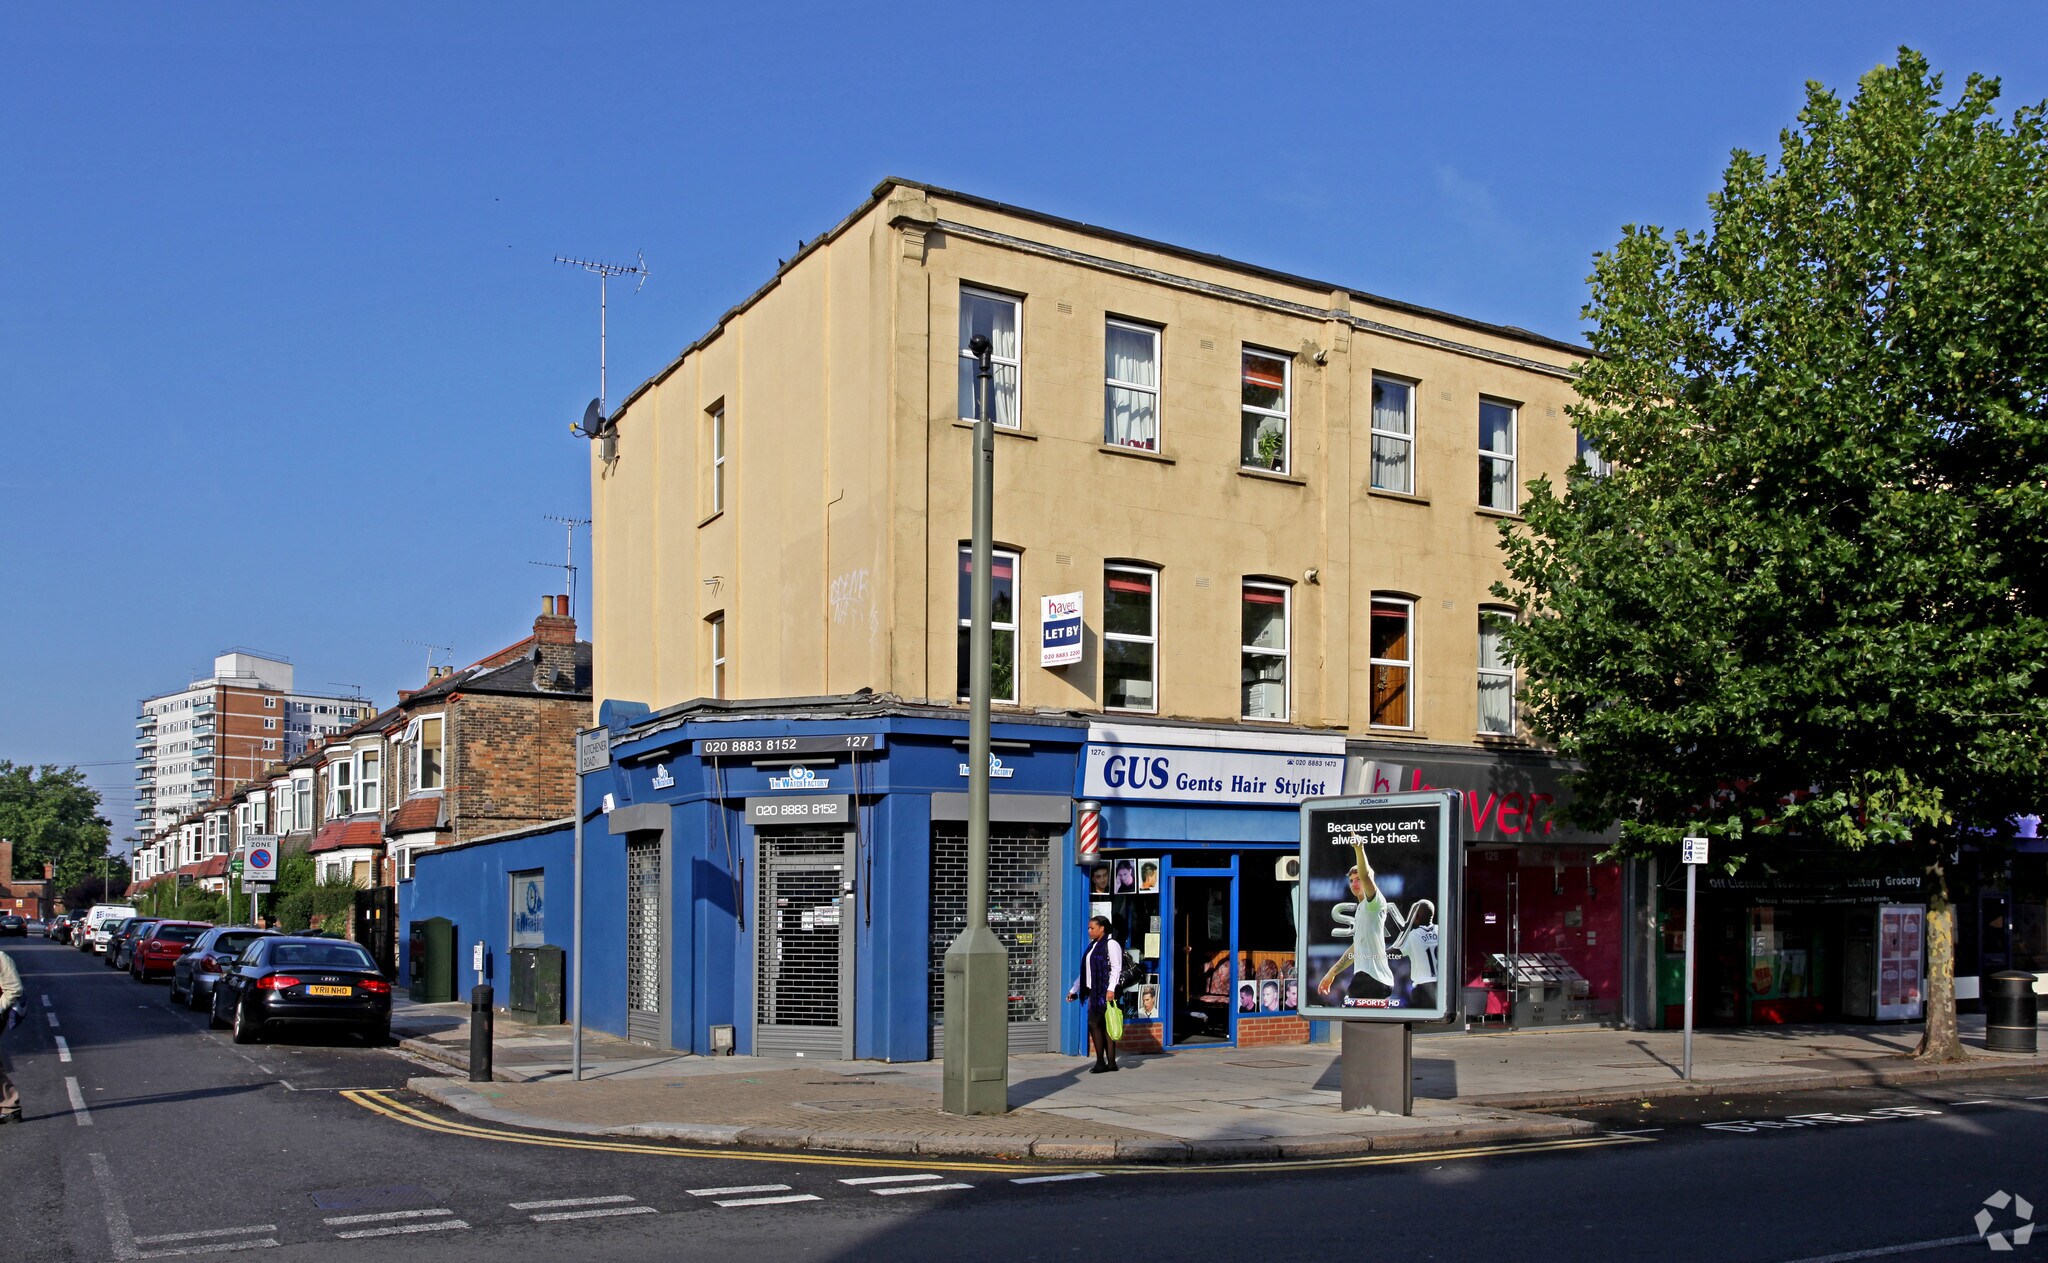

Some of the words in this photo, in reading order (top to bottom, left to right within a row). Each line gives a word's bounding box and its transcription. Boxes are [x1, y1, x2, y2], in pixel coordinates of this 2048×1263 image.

[1048, 599, 1075, 614] haven
[1045, 627, 1065, 640] LET
[1066, 625, 1079, 637] BY
[583, 740, 608, 756] KITCHENER
[705, 742, 728, 752] 020
[731, 740, 762, 751] 8883
[766, 739, 797, 750] 8152
[846, 736, 869, 747] 127
[583, 756, 596, 768] ROAD
[1103, 755, 1170, 790] GUS
[1176, 773, 1223, 792] Gents
[1231, 775, 1267, 793] Hair
[1274, 777, 1326, 798] Stylist
[756, 806, 778, 816] 020
[781, 805, 808, 815] 8883
[812, 804, 837, 814] 8152
[1327, 821, 1373, 833] Because
[1375, 822, 1396, 833] you
[1332, 834, 1369, 847] always
[1371, 834, 1385, 844] be
[1387, 833, 1421, 843] there.
[1710, 879, 1726, 888] Off
[1885, 876, 1921, 887] Grocery
[1356, 999, 1386, 1007] SPORTS
[1701, 1106, 1943, 1133] DISABLED
